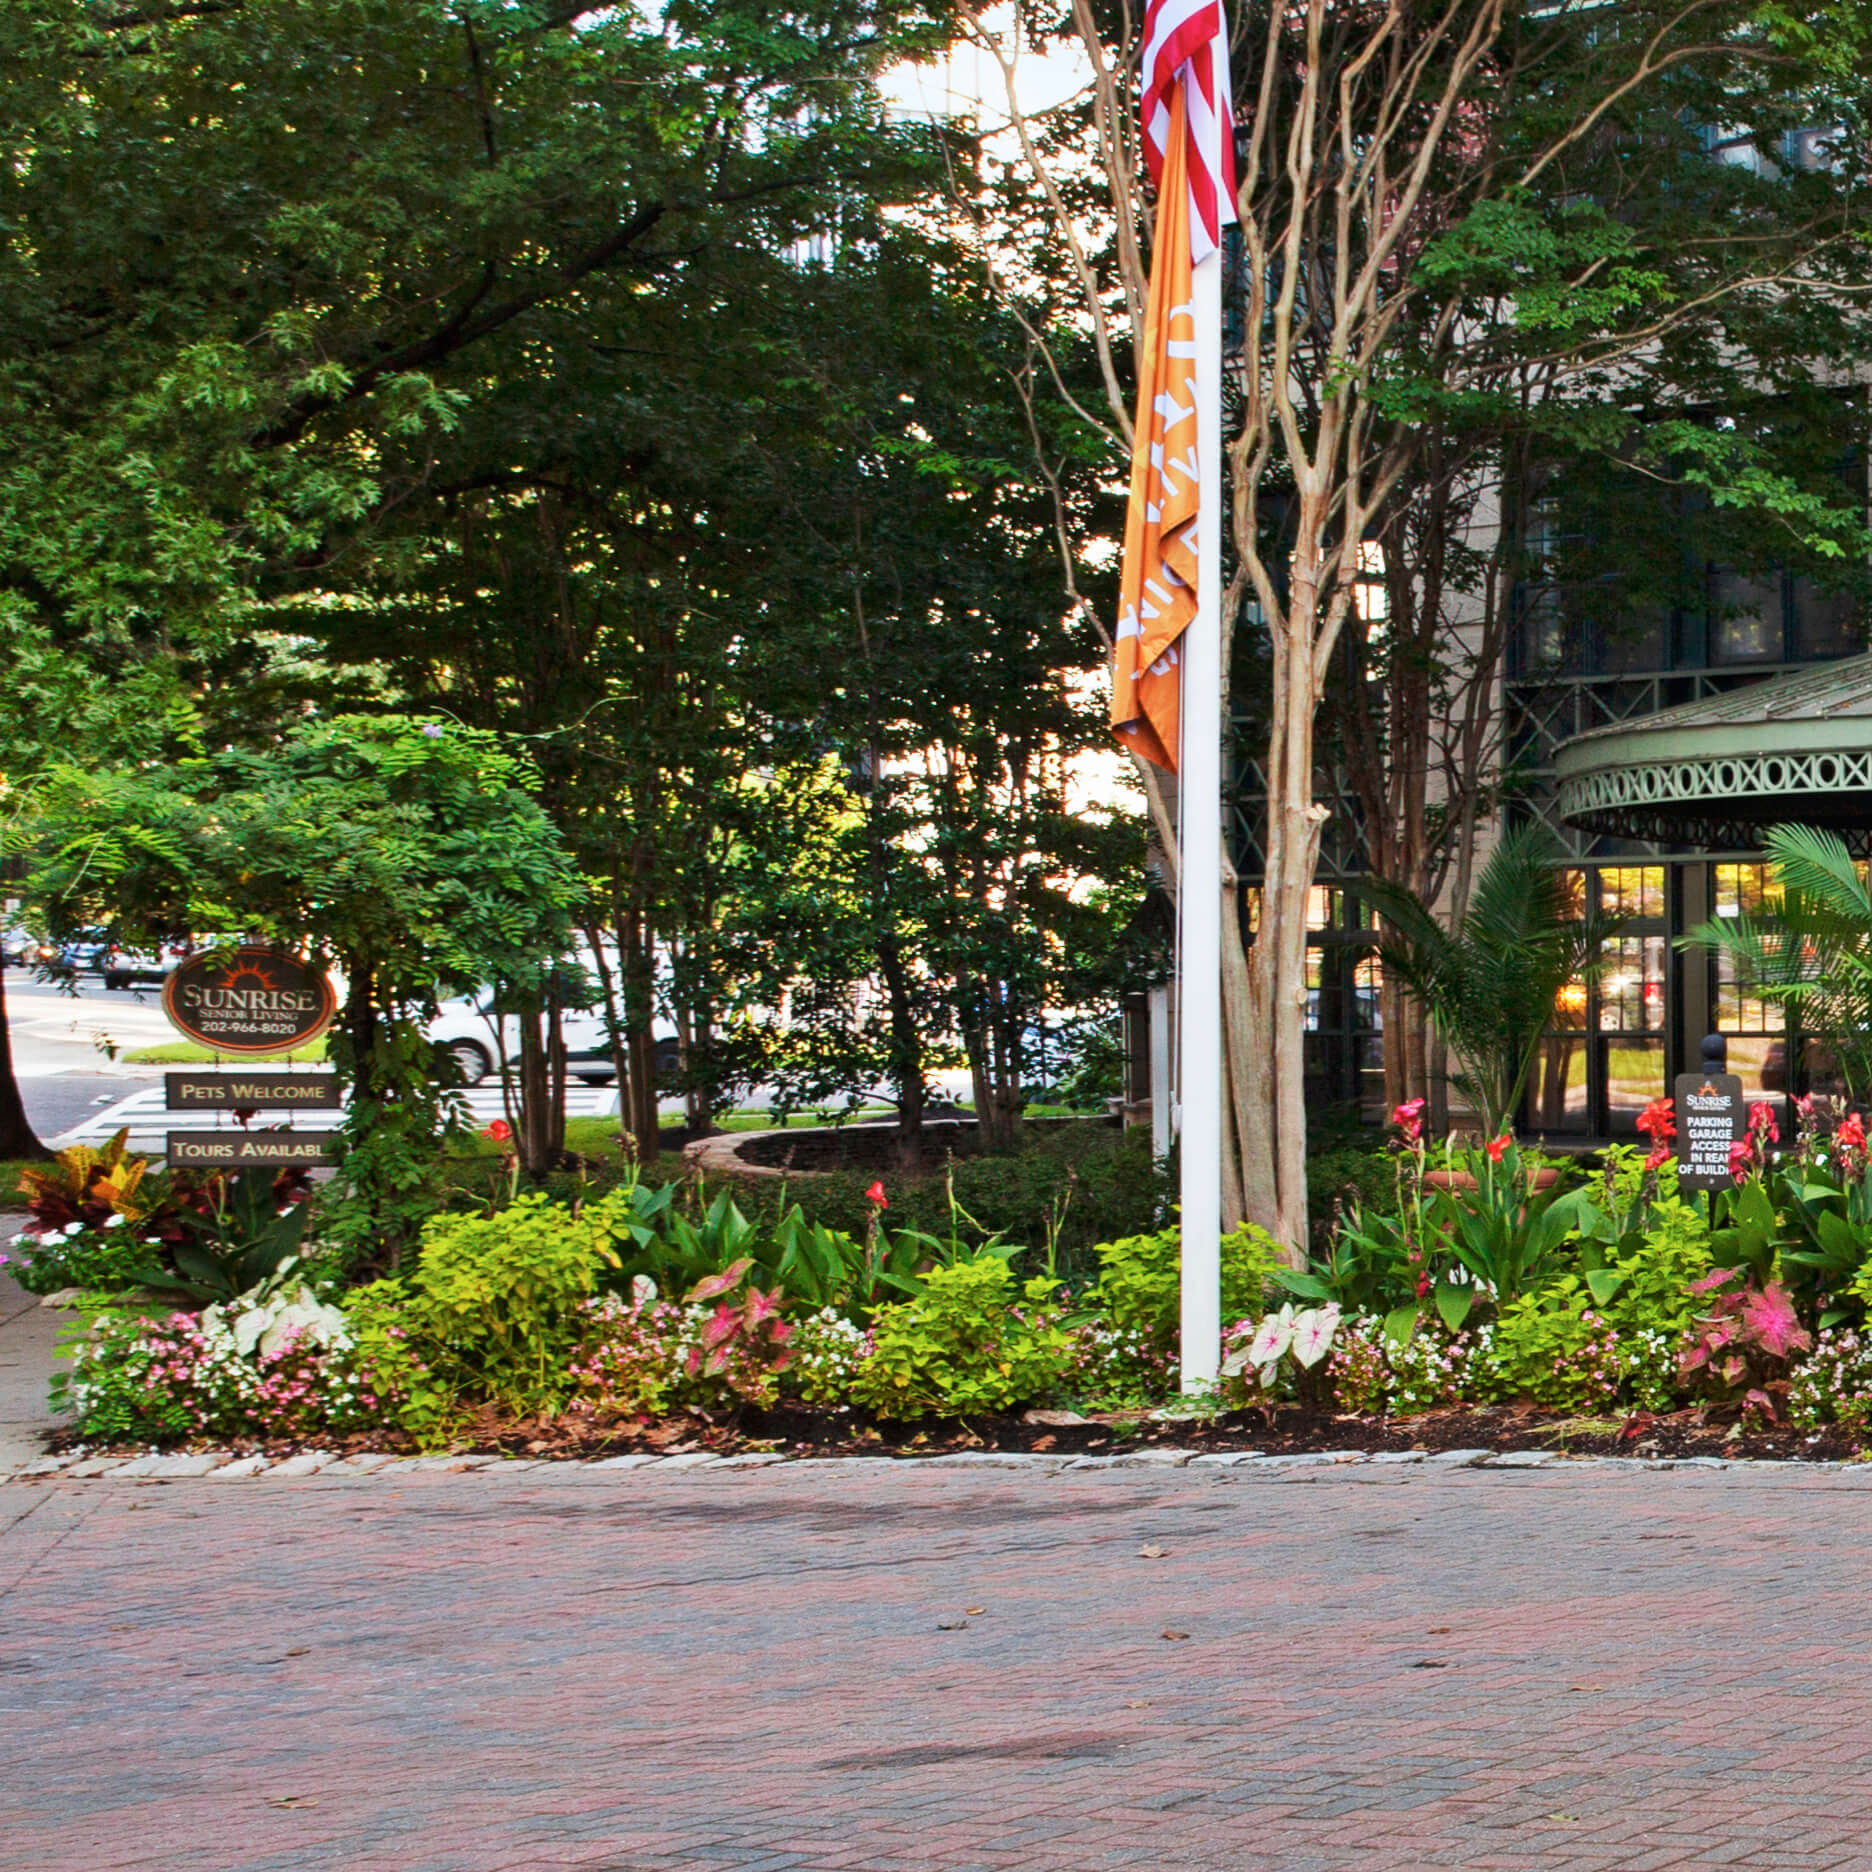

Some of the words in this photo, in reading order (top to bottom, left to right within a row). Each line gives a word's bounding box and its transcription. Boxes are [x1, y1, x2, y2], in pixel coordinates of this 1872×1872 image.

[183, 984, 316, 1010] SUNRISE
[199, 1008, 248, 1020] SENIOR
[252, 1009, 299, 1021] LIVING
[201, 1021, 296, 1034] 202-966-8020
[181, 1084, 225, 1099] PETS
[231, 1084, 325, 1099] WELCOME
[1686, 1094, 1732, 1107] SUNRISE
[1687, 1116, 1733, 1128] PARKING
[1688, 1129, 1733, 1140] GARAGE
[173, 1142, 234, 1157] TOURS
[1690, 1140, 1731, 1152] ACCESS
[1690, 1152, 1702, 1163] IN
[1678, 1164, 1693, 1175] OF
